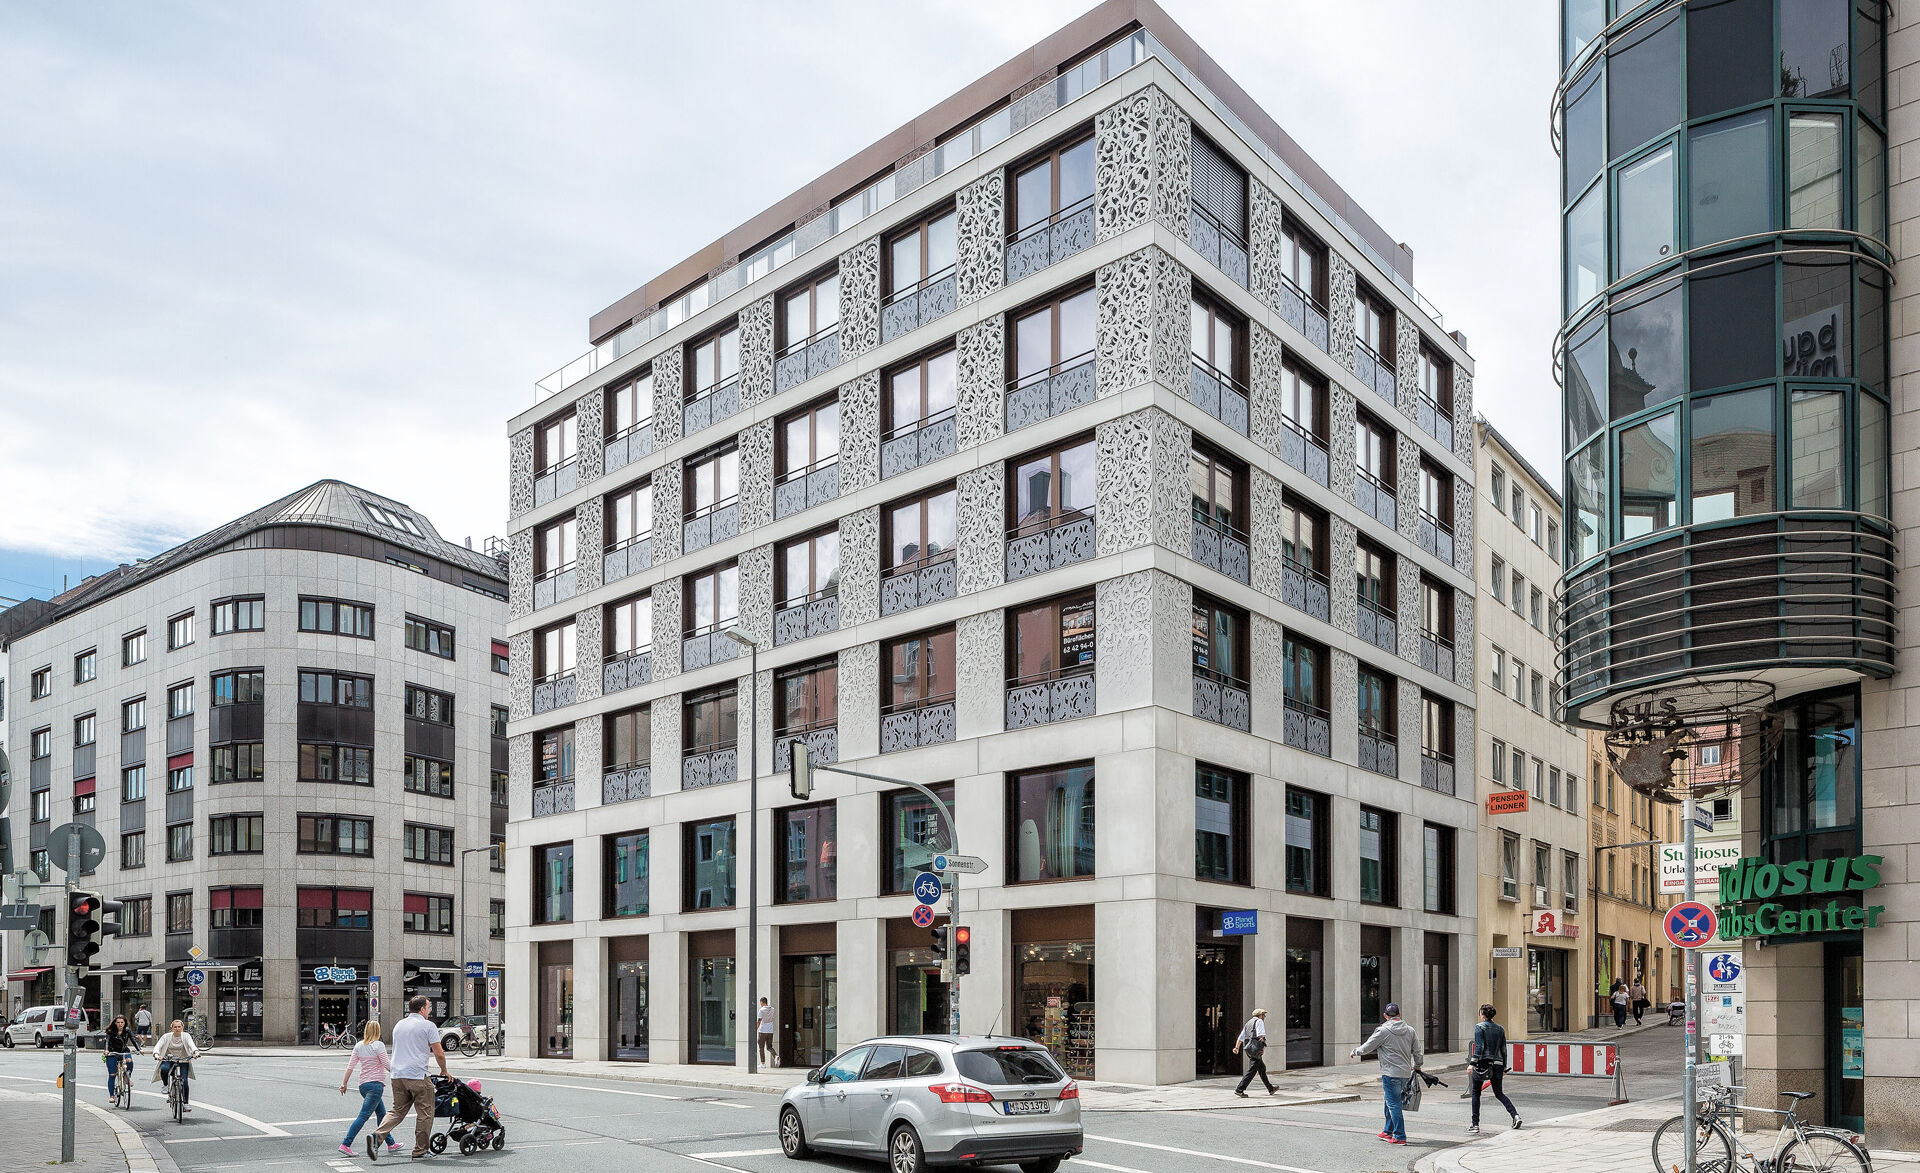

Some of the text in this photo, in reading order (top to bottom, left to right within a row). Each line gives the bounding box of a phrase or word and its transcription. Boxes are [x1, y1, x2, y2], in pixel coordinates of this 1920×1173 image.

[1491, 794, 1525, 803] PENSION
[1491, 802, 1525, 811] LINDNER
[948, 859, 976, 869] Sonnenstr.
[331, 973, 355, 981] Sports
[1020, 1102, 1030, 1110] JS
[1031, 1100, 1049, 1109] 1378
